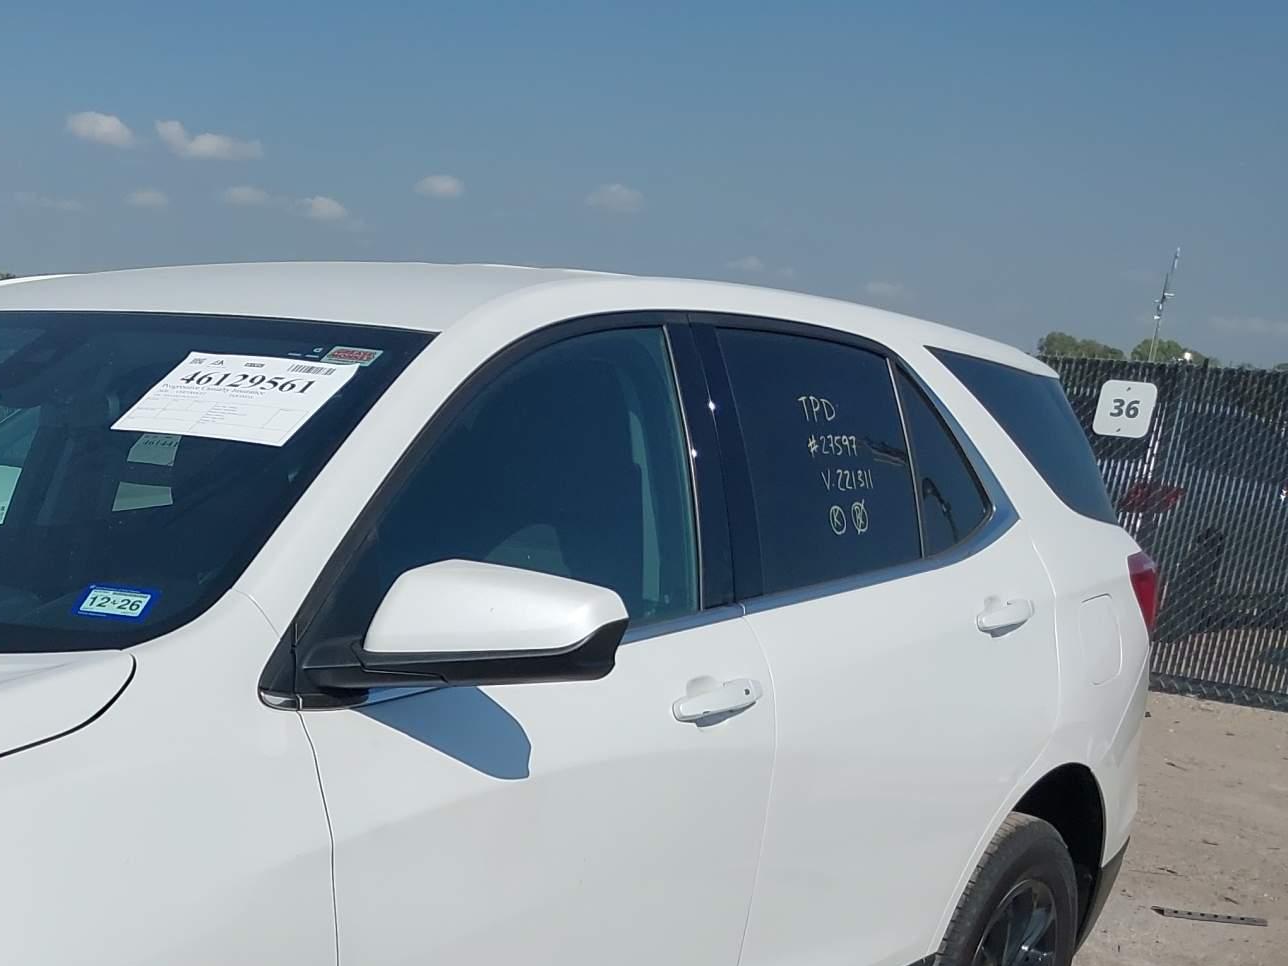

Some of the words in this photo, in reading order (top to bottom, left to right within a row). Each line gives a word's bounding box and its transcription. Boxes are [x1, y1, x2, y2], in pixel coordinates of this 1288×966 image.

[180, 371, 316, 394] 46129561
[798, 396, 836, 422] TPD
[1109, 399, 1140, 419] 36
[808, 434, 858, 458] #27597
[89, 595, 111, 608] 12
[117, 598, 143, 611] 26
